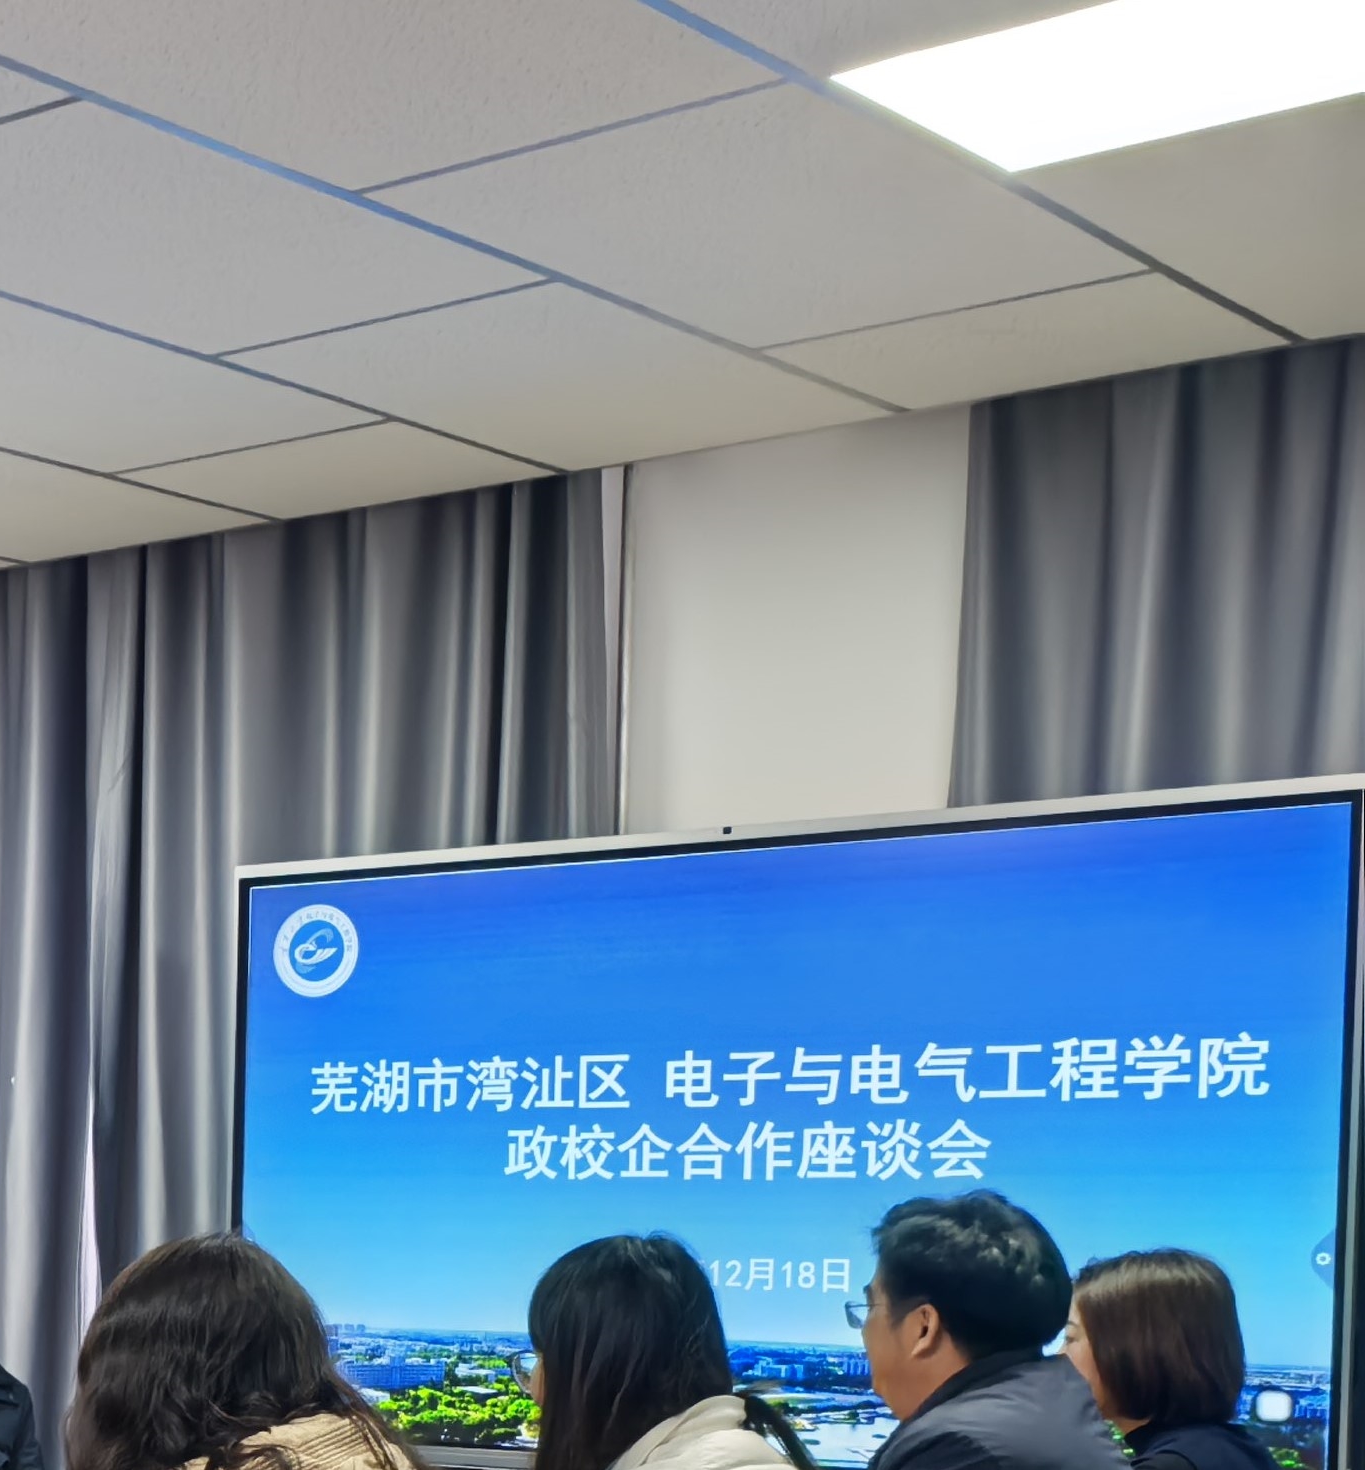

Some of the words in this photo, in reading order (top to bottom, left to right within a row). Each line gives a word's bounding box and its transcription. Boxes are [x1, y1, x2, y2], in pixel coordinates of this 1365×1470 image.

[309, 1052, 632, 1115] 芜湖市湾沚区
[663, 1033, 1271, 1107] 电子与电气工程学院
[504, 1119, 992, 1181] 政校企合作座谈会
